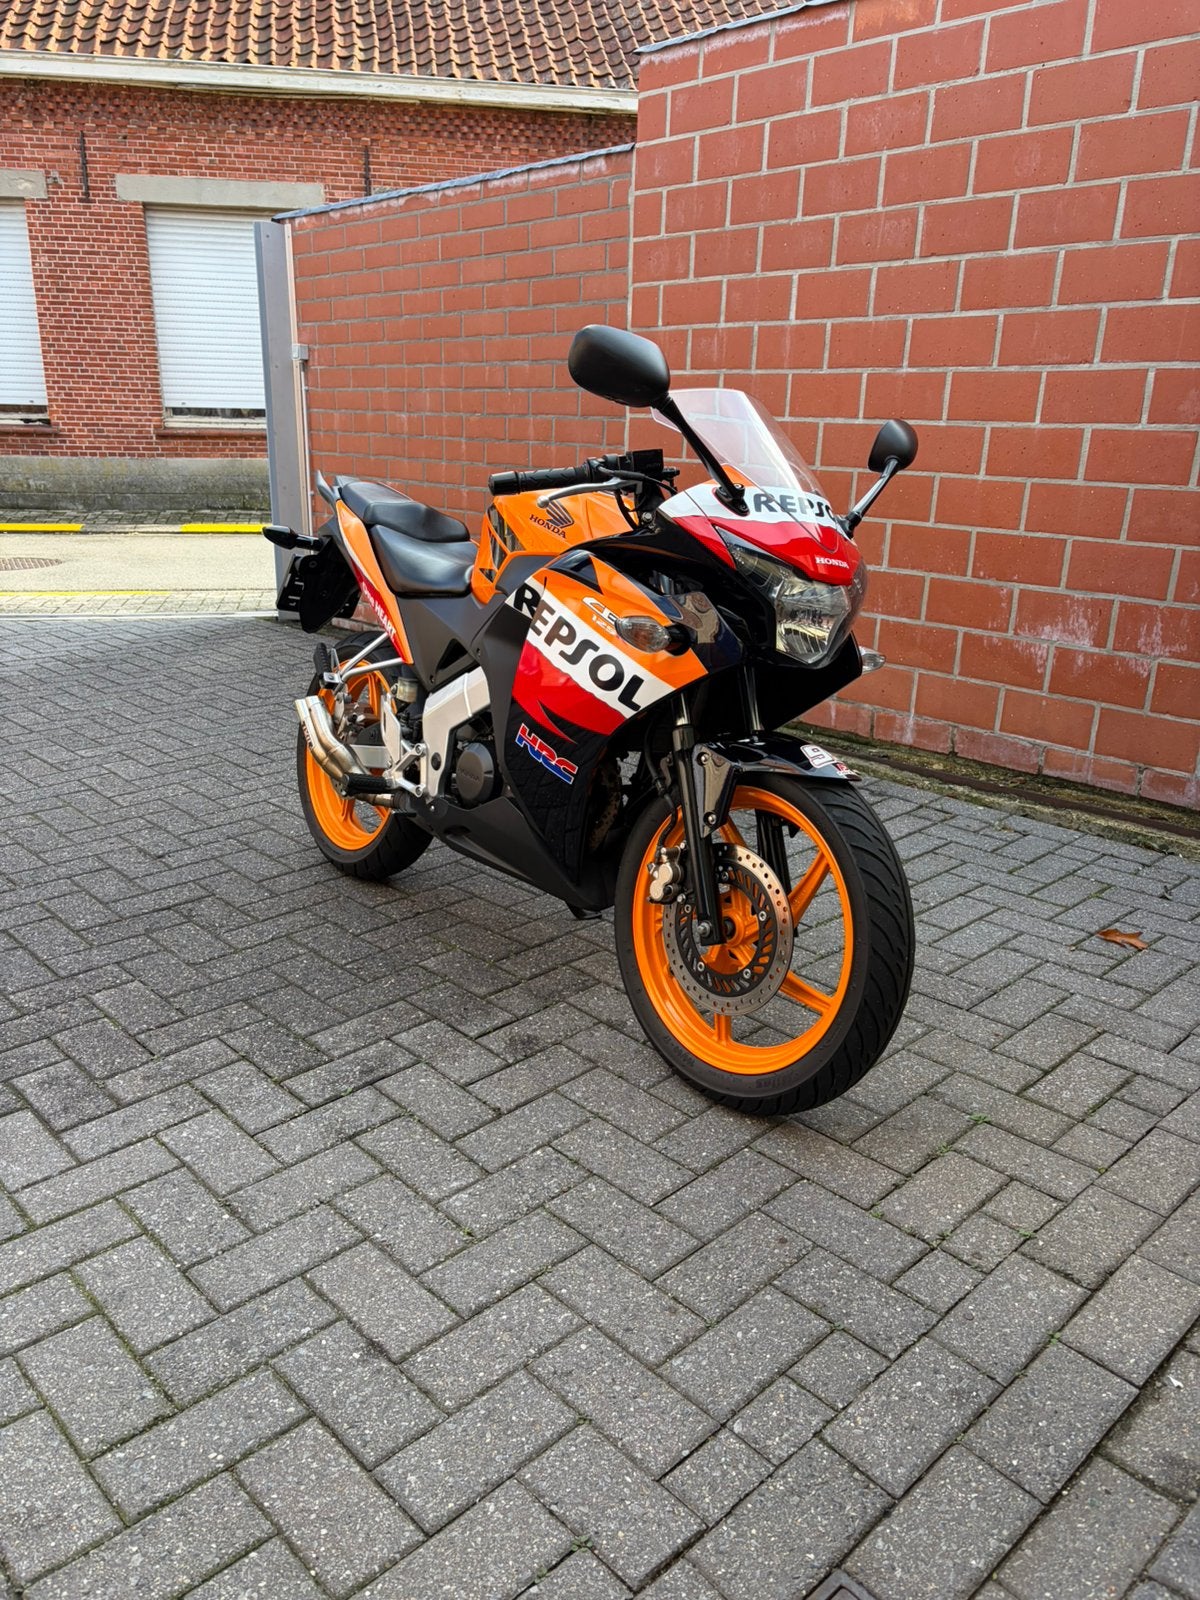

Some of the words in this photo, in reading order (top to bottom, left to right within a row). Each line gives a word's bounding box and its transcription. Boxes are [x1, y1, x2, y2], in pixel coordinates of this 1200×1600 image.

[529, 513, 567, 539] HONDA
[814, 554, 850, 569] HONDA
[514, 583, 645, 712] REPSOL
[515, 722, 579, 785] HRC
